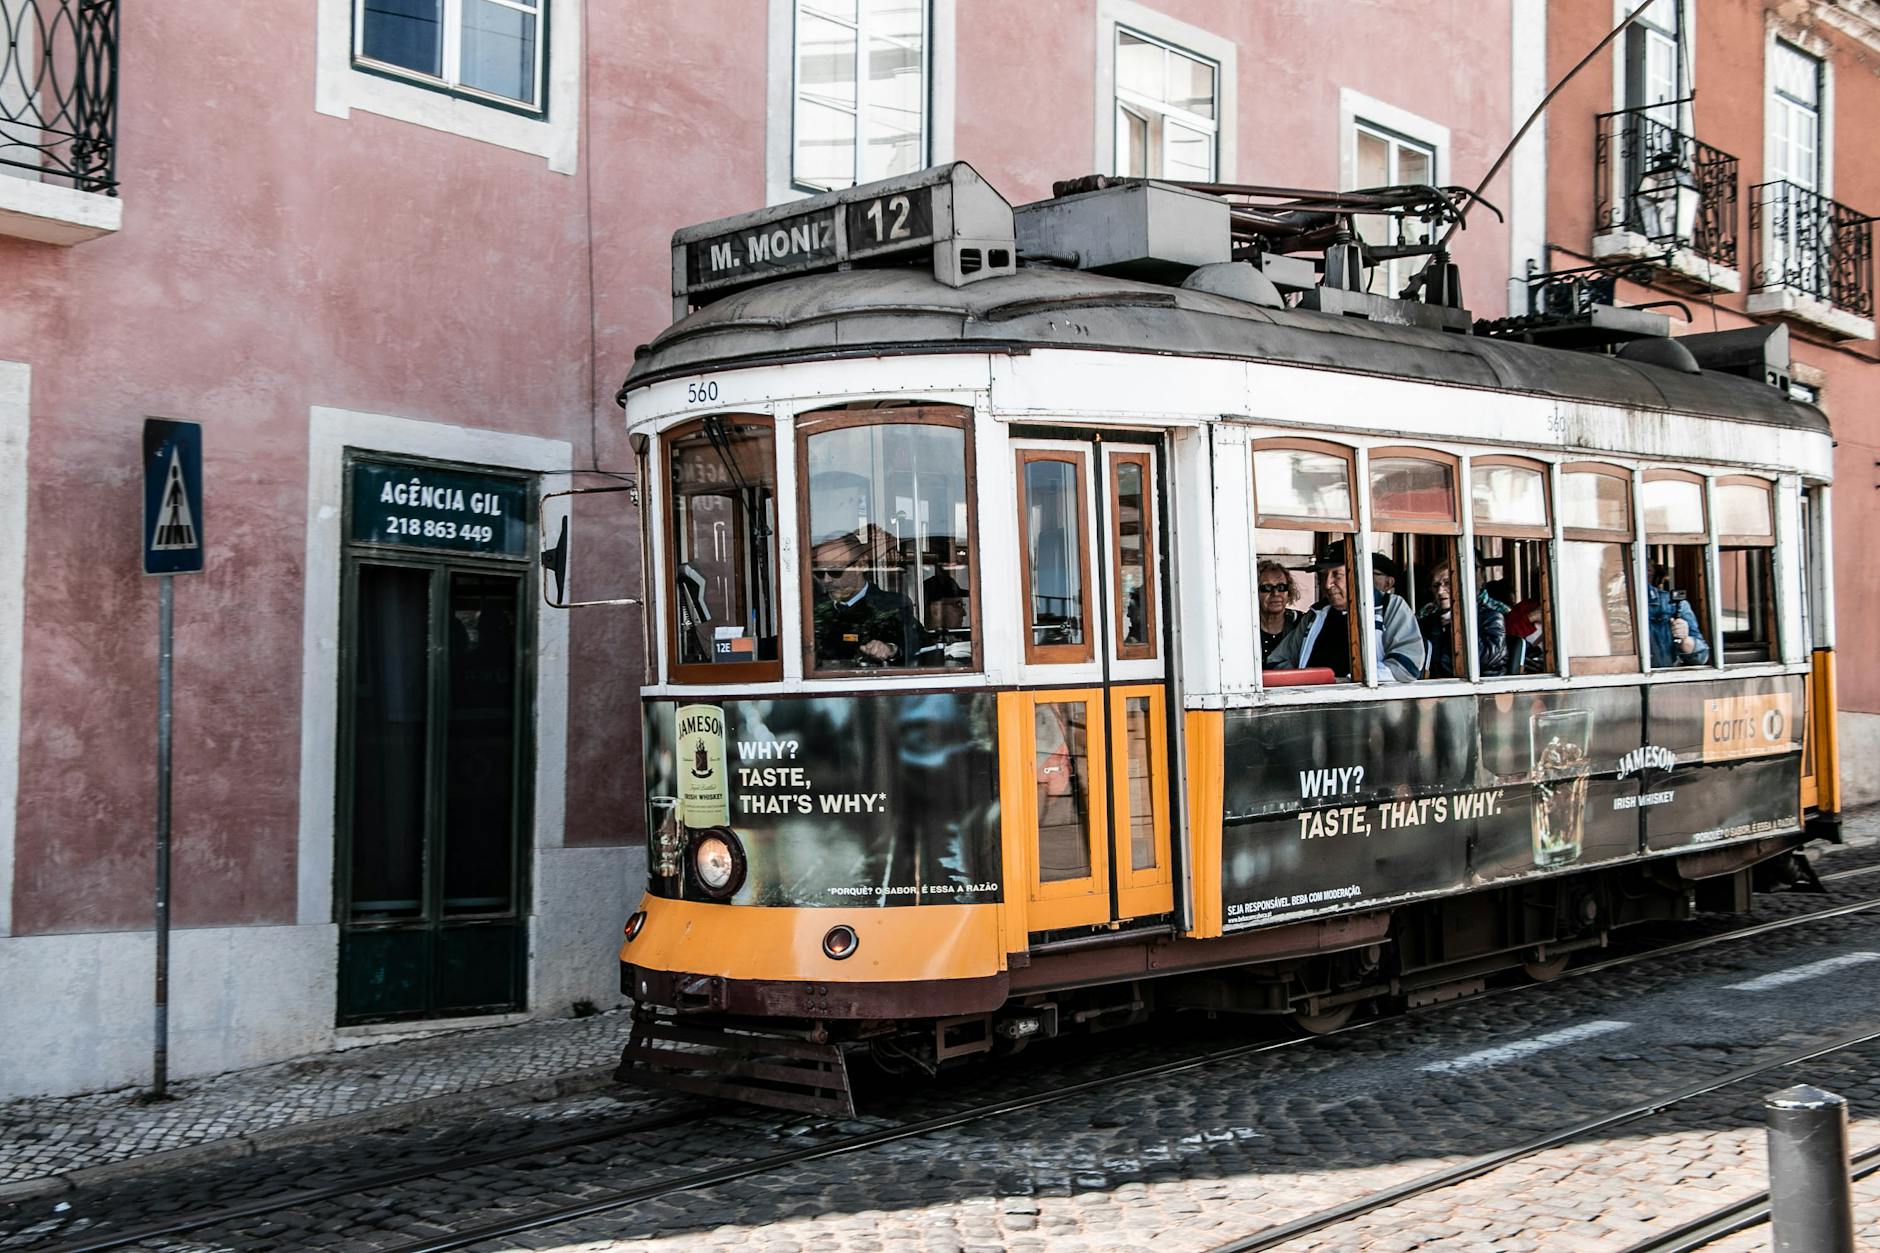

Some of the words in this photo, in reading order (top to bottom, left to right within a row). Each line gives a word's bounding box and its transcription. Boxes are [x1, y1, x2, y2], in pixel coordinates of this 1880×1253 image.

[867, 195, 911, 242] 12
[710, 242, 740, 272] M.
[748, 219, 835, 264] MONIZ
[688, 381, 718, 404] 560
[1547, 415, 1566, 432] 560
[380, 477, 465, 512] AGÊNCIA
[470, 492, 502, 516] GIL
[386, 516, 421, 535] 218
[423, 520, 457, 539] 863
[459, 524, 493, 542] 449
[716, 642, 731, 653] 12E
[679, 715, 723, 740] JAMESON
[1713, 710, 1756, 742] carris
[737, 740, 799, 760] WHY?
[1617, 745, 1676, 780] JAMESON
[738, 767, 812, 790] TASTE,
[1300, 766, 1364, 798] WHY?
[739, 795, 813, 814] THAT'S
[1613, 795, 1637, 810] IRISH
[1638, 790, 1675, 807] WHISKEY
[1298, 805, 1372, 840] TASTE,
[1379, 796, 1447, 830] THAT'S
[875, 887, 882, 895] O
[921, 884, 928, 894] É
[930, 885, 954, 894] ESSA
[956, 885, 964, 893] A
[966, 881, 998, 892] RAZÃO
[1227, 903, 1244, 916] SEJA
[1245, 896, 1291, 913] RESPONSÁVEL.
[1291, 894, 1308, 906] BEBA
[1309, 890, 1323, 903] COM
[1323, 884, 1361, 899] MODERAÇÃO.
